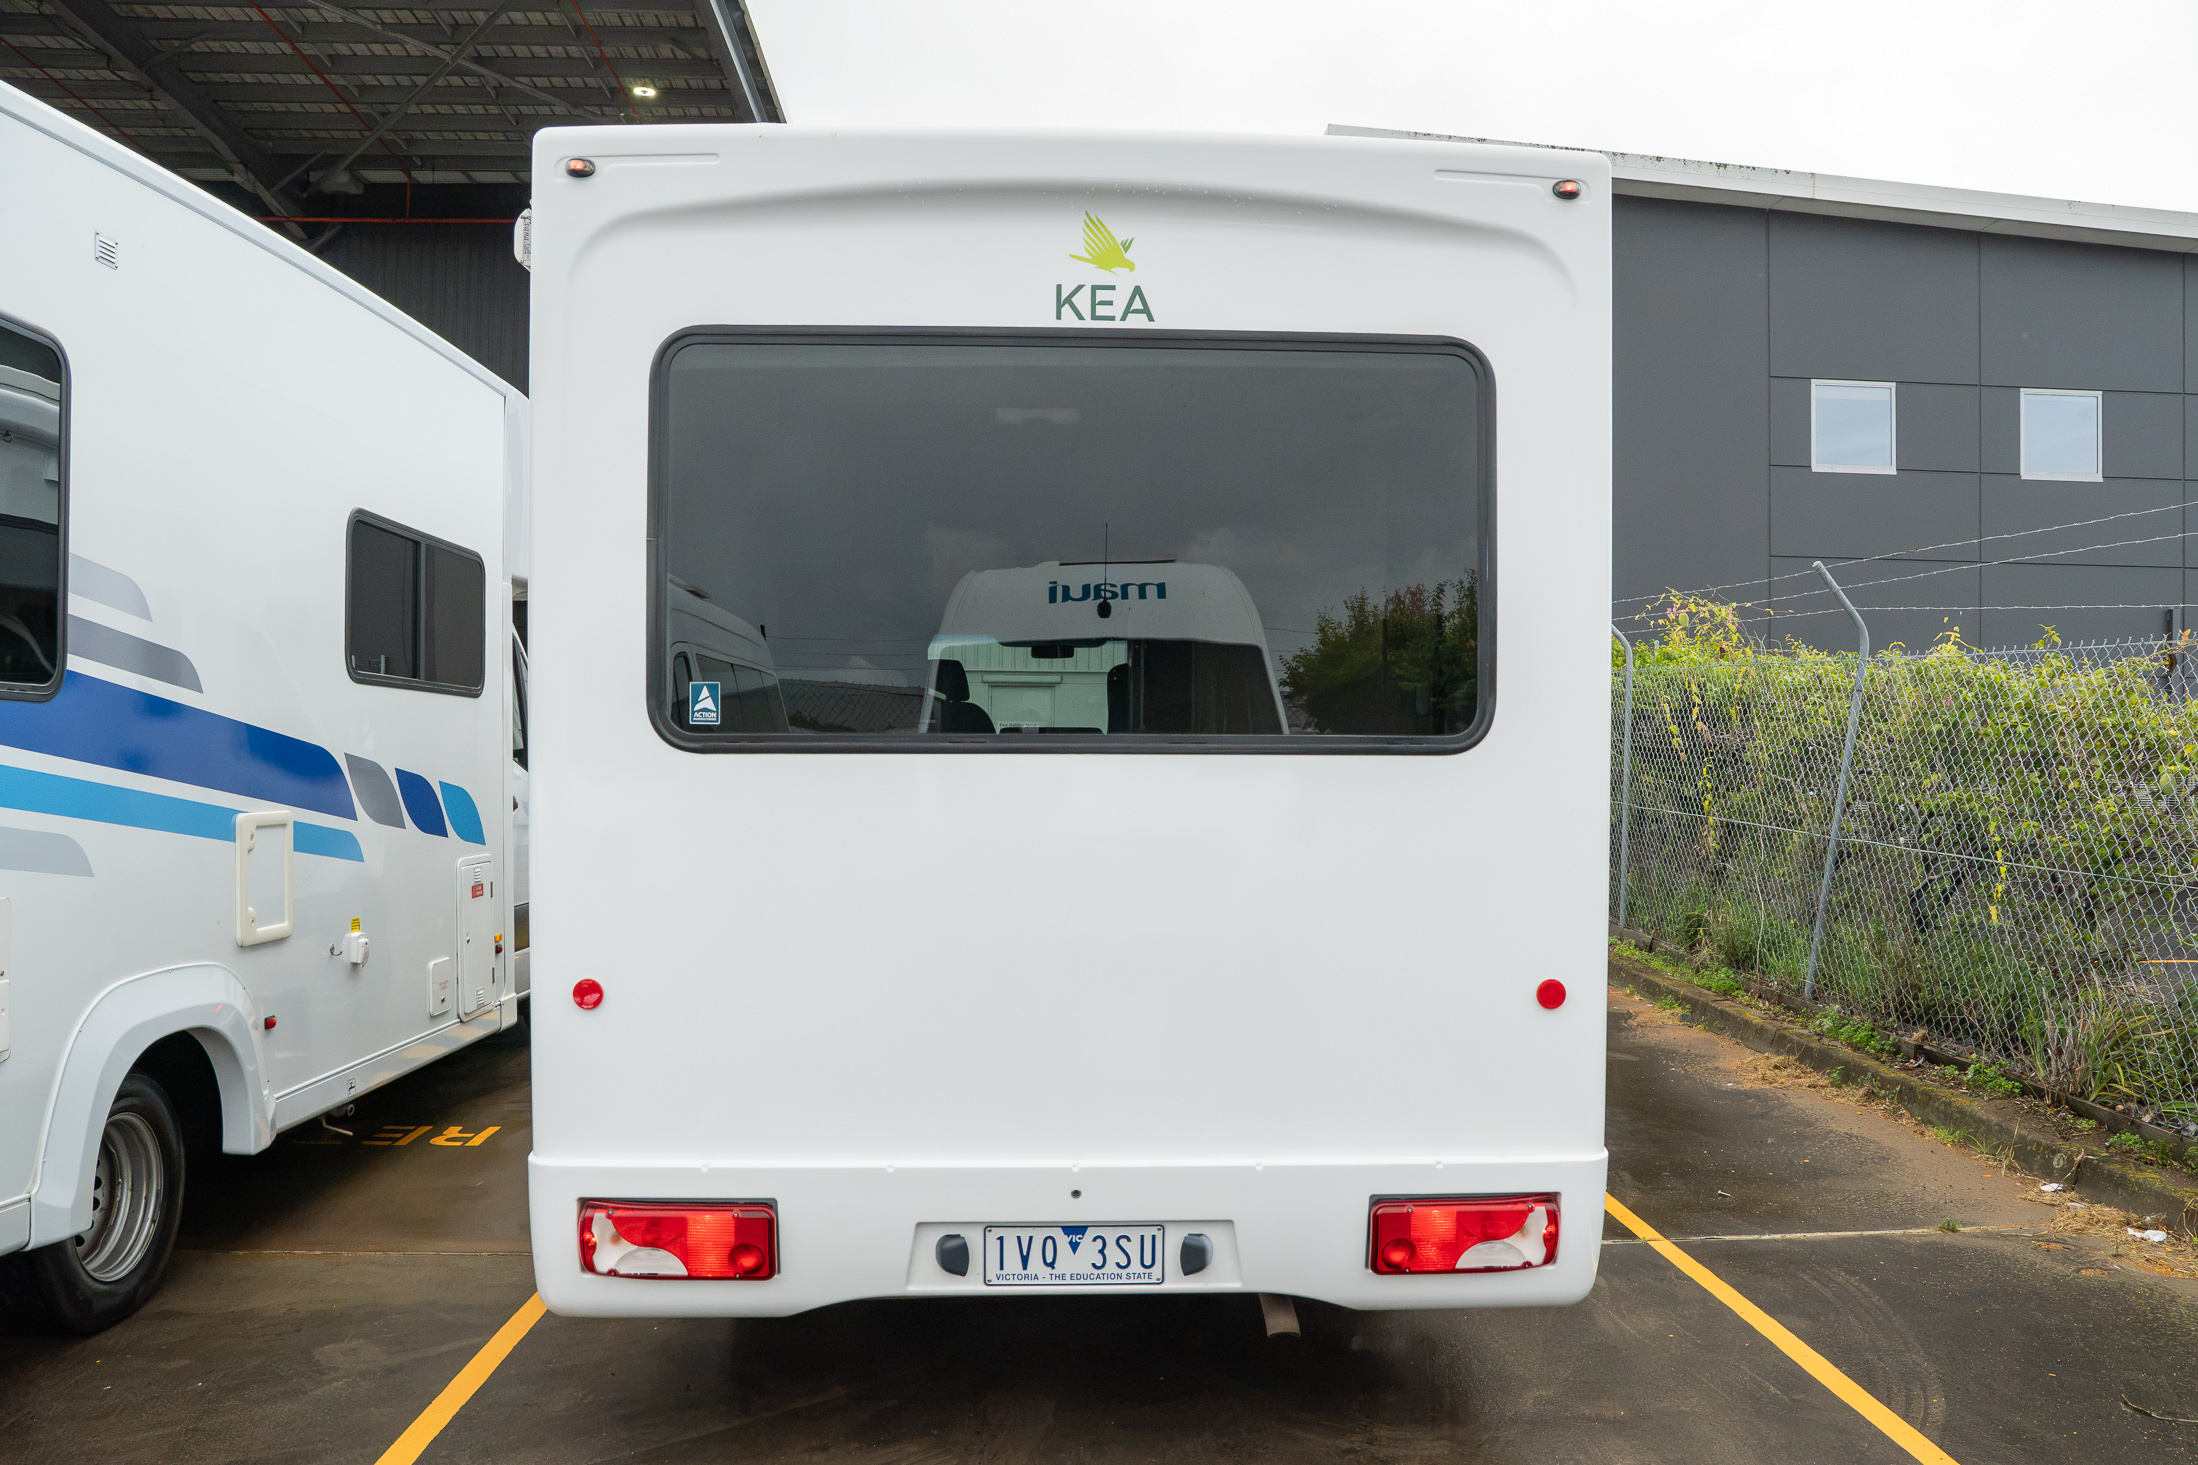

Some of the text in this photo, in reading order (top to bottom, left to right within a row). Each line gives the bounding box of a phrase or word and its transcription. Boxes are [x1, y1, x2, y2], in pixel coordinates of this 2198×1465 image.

[1055, 283, 1156, 322] KEA
[1065, 1234, 1084, 1243] VIC
[996, 1234, 1156, 1271] 1VQ 3SU
[995, 1273, 1039, 1281] VICTORIA
[1049, 1273, 1067, 1281] THE
[1069, 1272, 1123, 1281] EDUCATION
[1125, 1272, 1153, 1280] STATE
